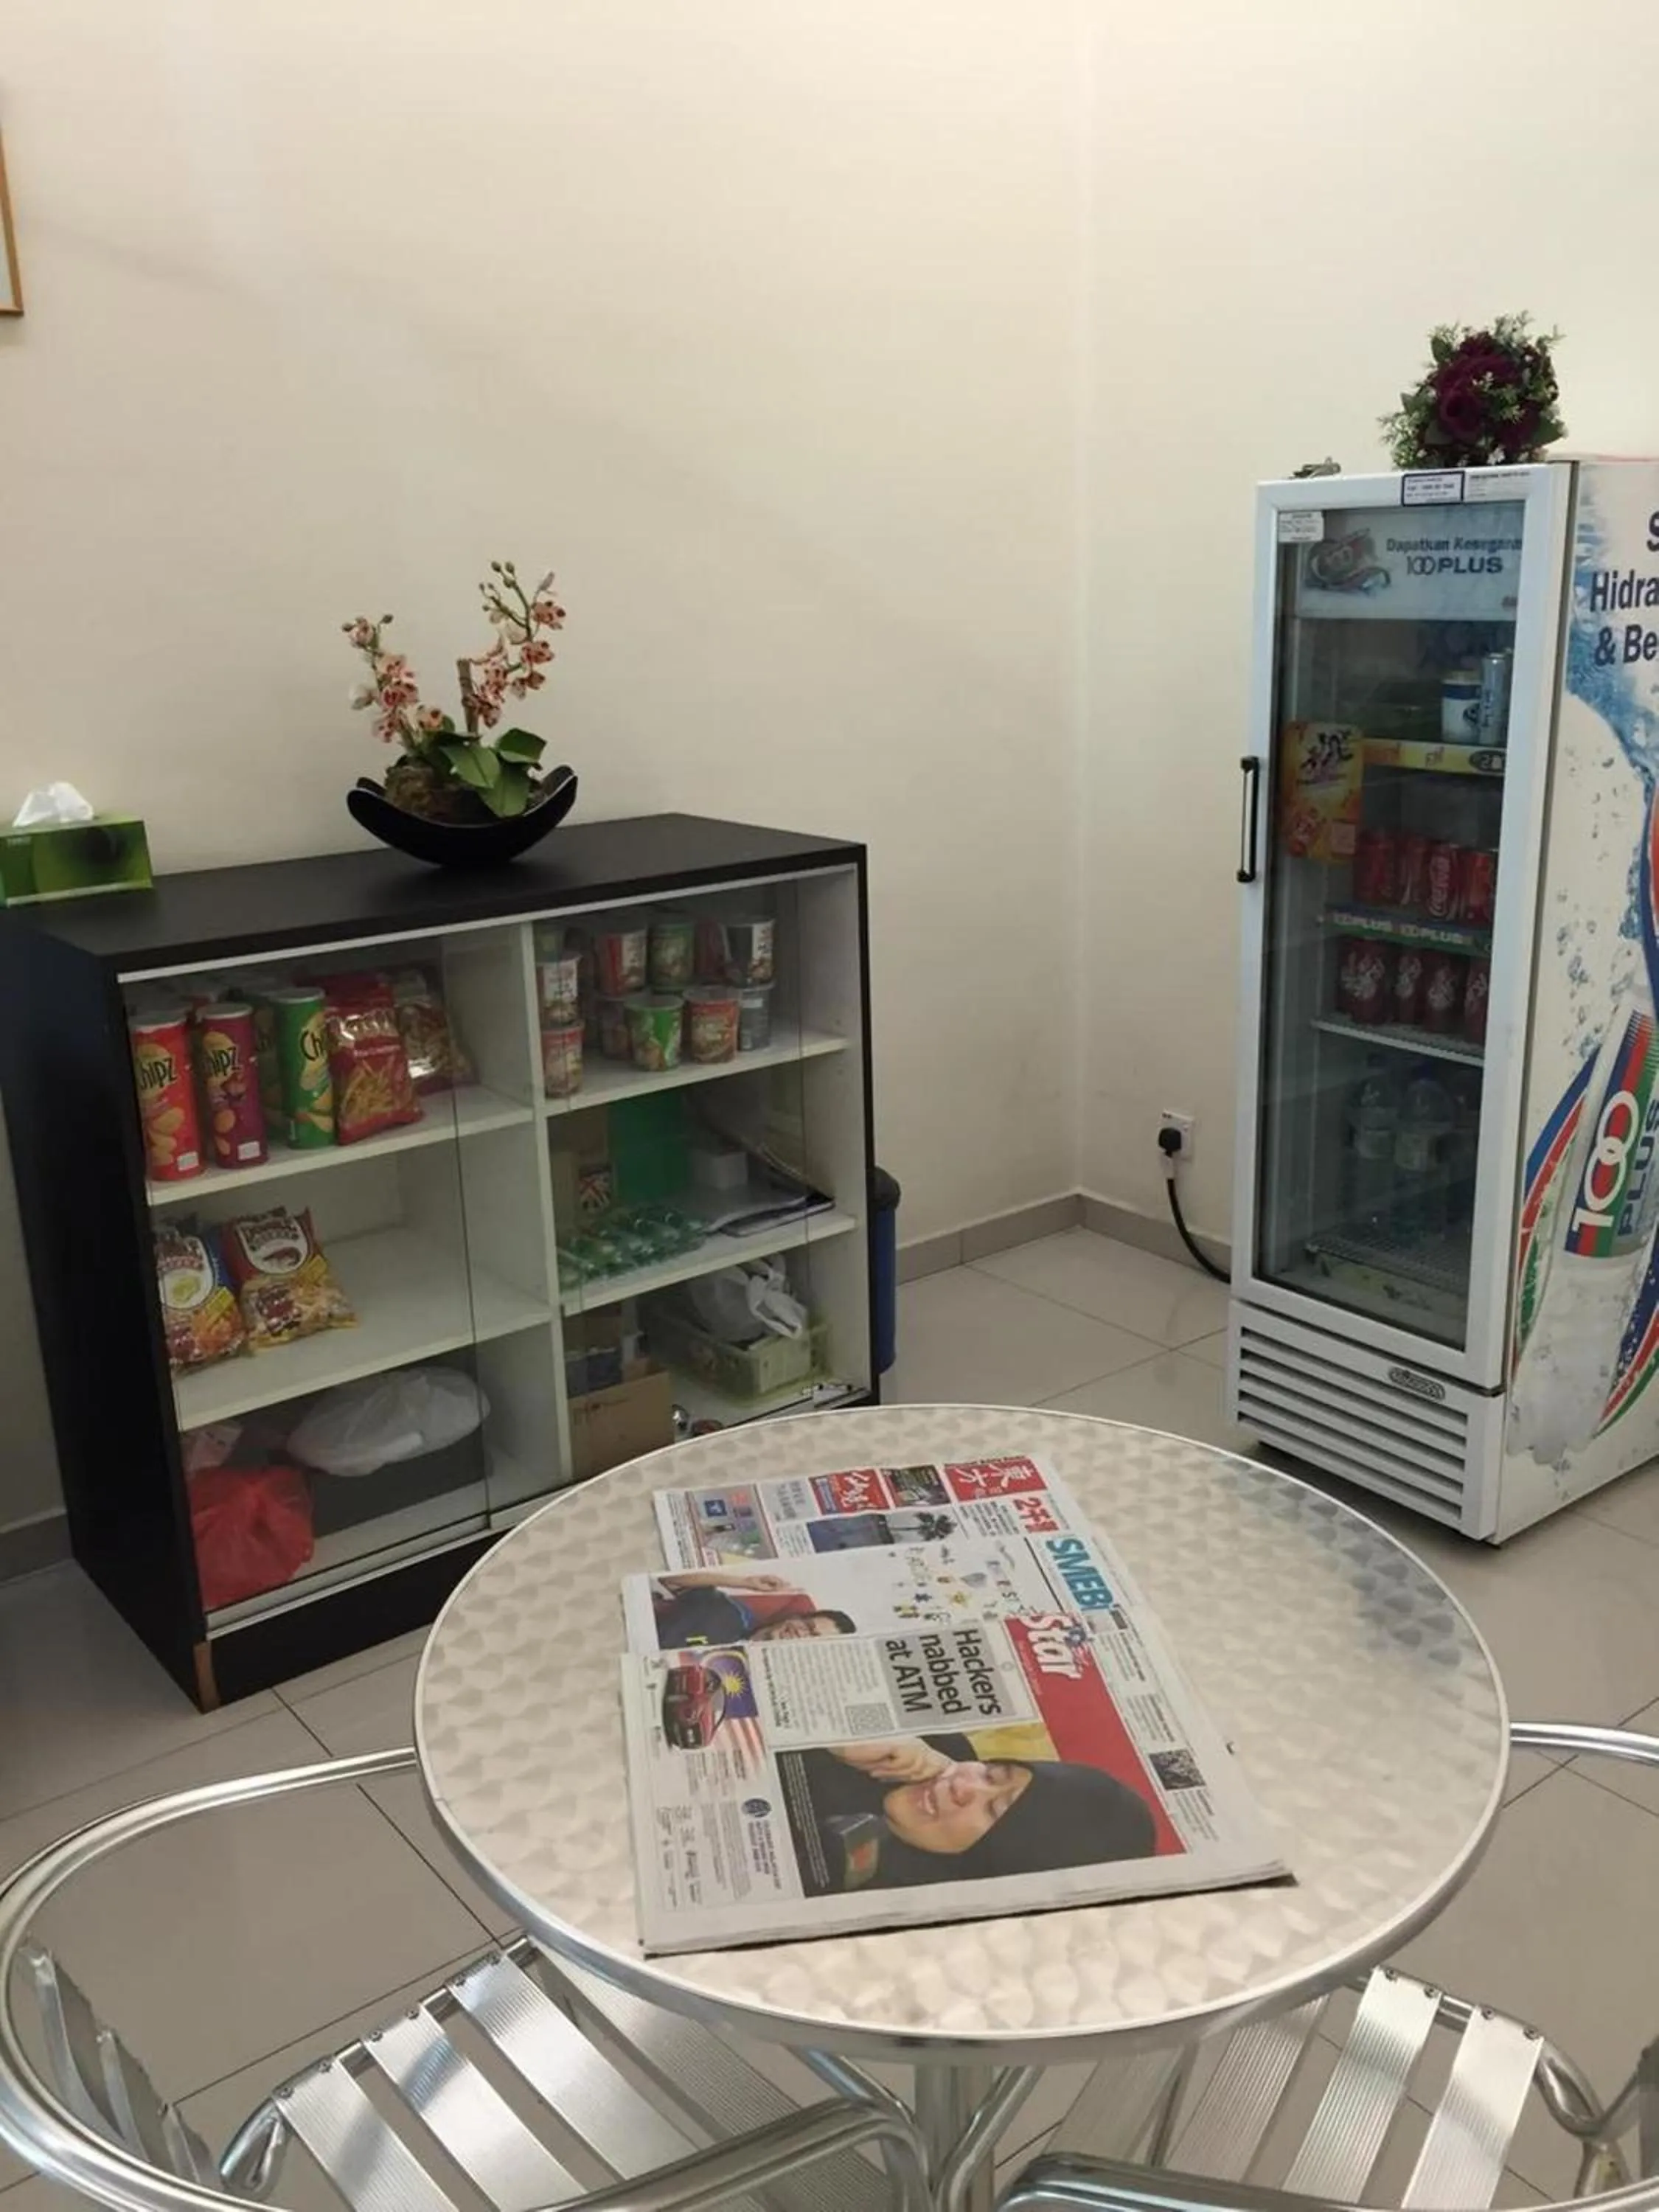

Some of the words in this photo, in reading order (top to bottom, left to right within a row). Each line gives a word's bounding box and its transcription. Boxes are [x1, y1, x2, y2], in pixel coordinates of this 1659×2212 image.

[1590, 568, 1659, 612] Hidra
[1595, 626, 1616, 667] &
[886, 1639, 914, 1661] at
[1017, 1614, 1082, 1680] Star
[892, 1664, 933, 1712] ATM
[919, 1634, 972, 1715] nabbed
[953, 1629, 1002, 1715] Hackers
